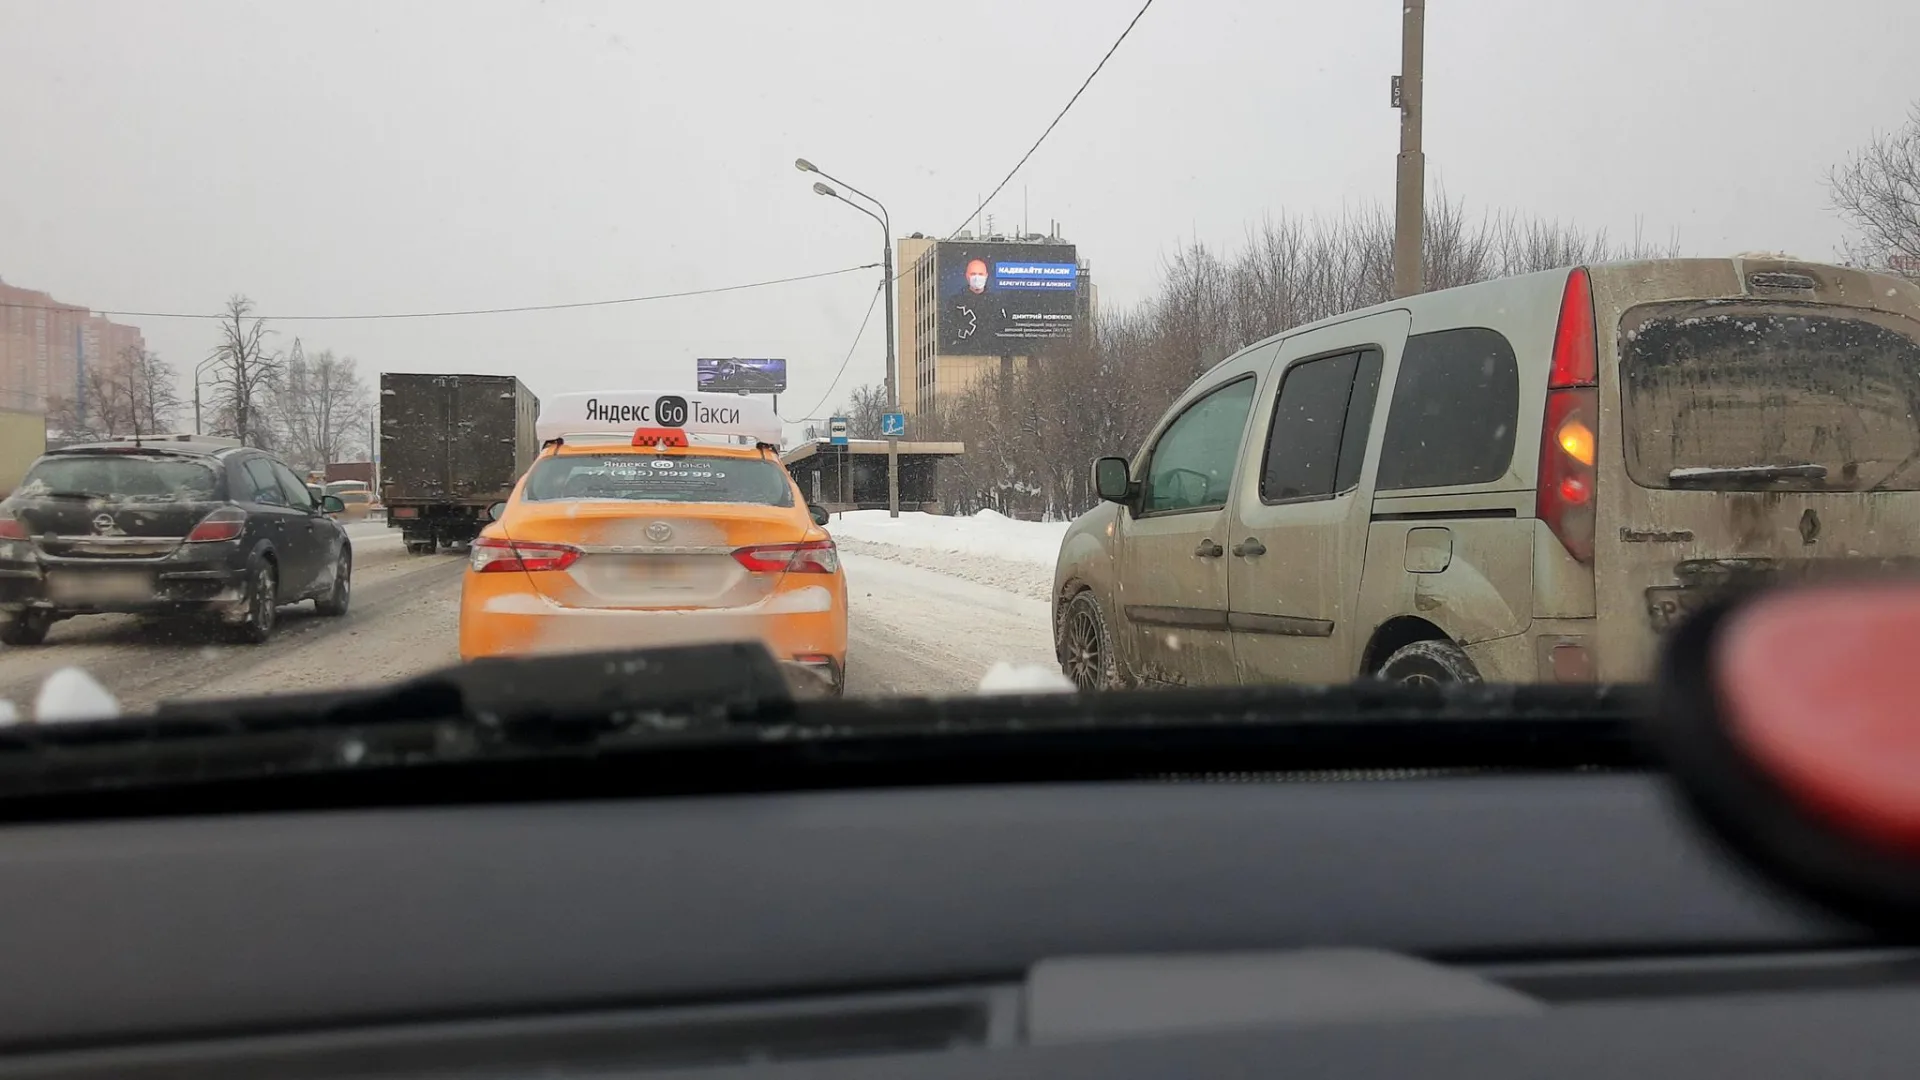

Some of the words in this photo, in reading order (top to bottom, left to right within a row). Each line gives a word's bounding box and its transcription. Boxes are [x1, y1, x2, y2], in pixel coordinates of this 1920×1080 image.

[998, 266, 1042, 275] НАДЕВАЙТЕ
[1043, 267, 1070, 275] МАСКИ
[586, 398, 650, 423] Яндекс
[658, 399, 685, 423] Go
[691, 401, 740, 424] Такси
[603, 461, 647, 469] Яндекс
